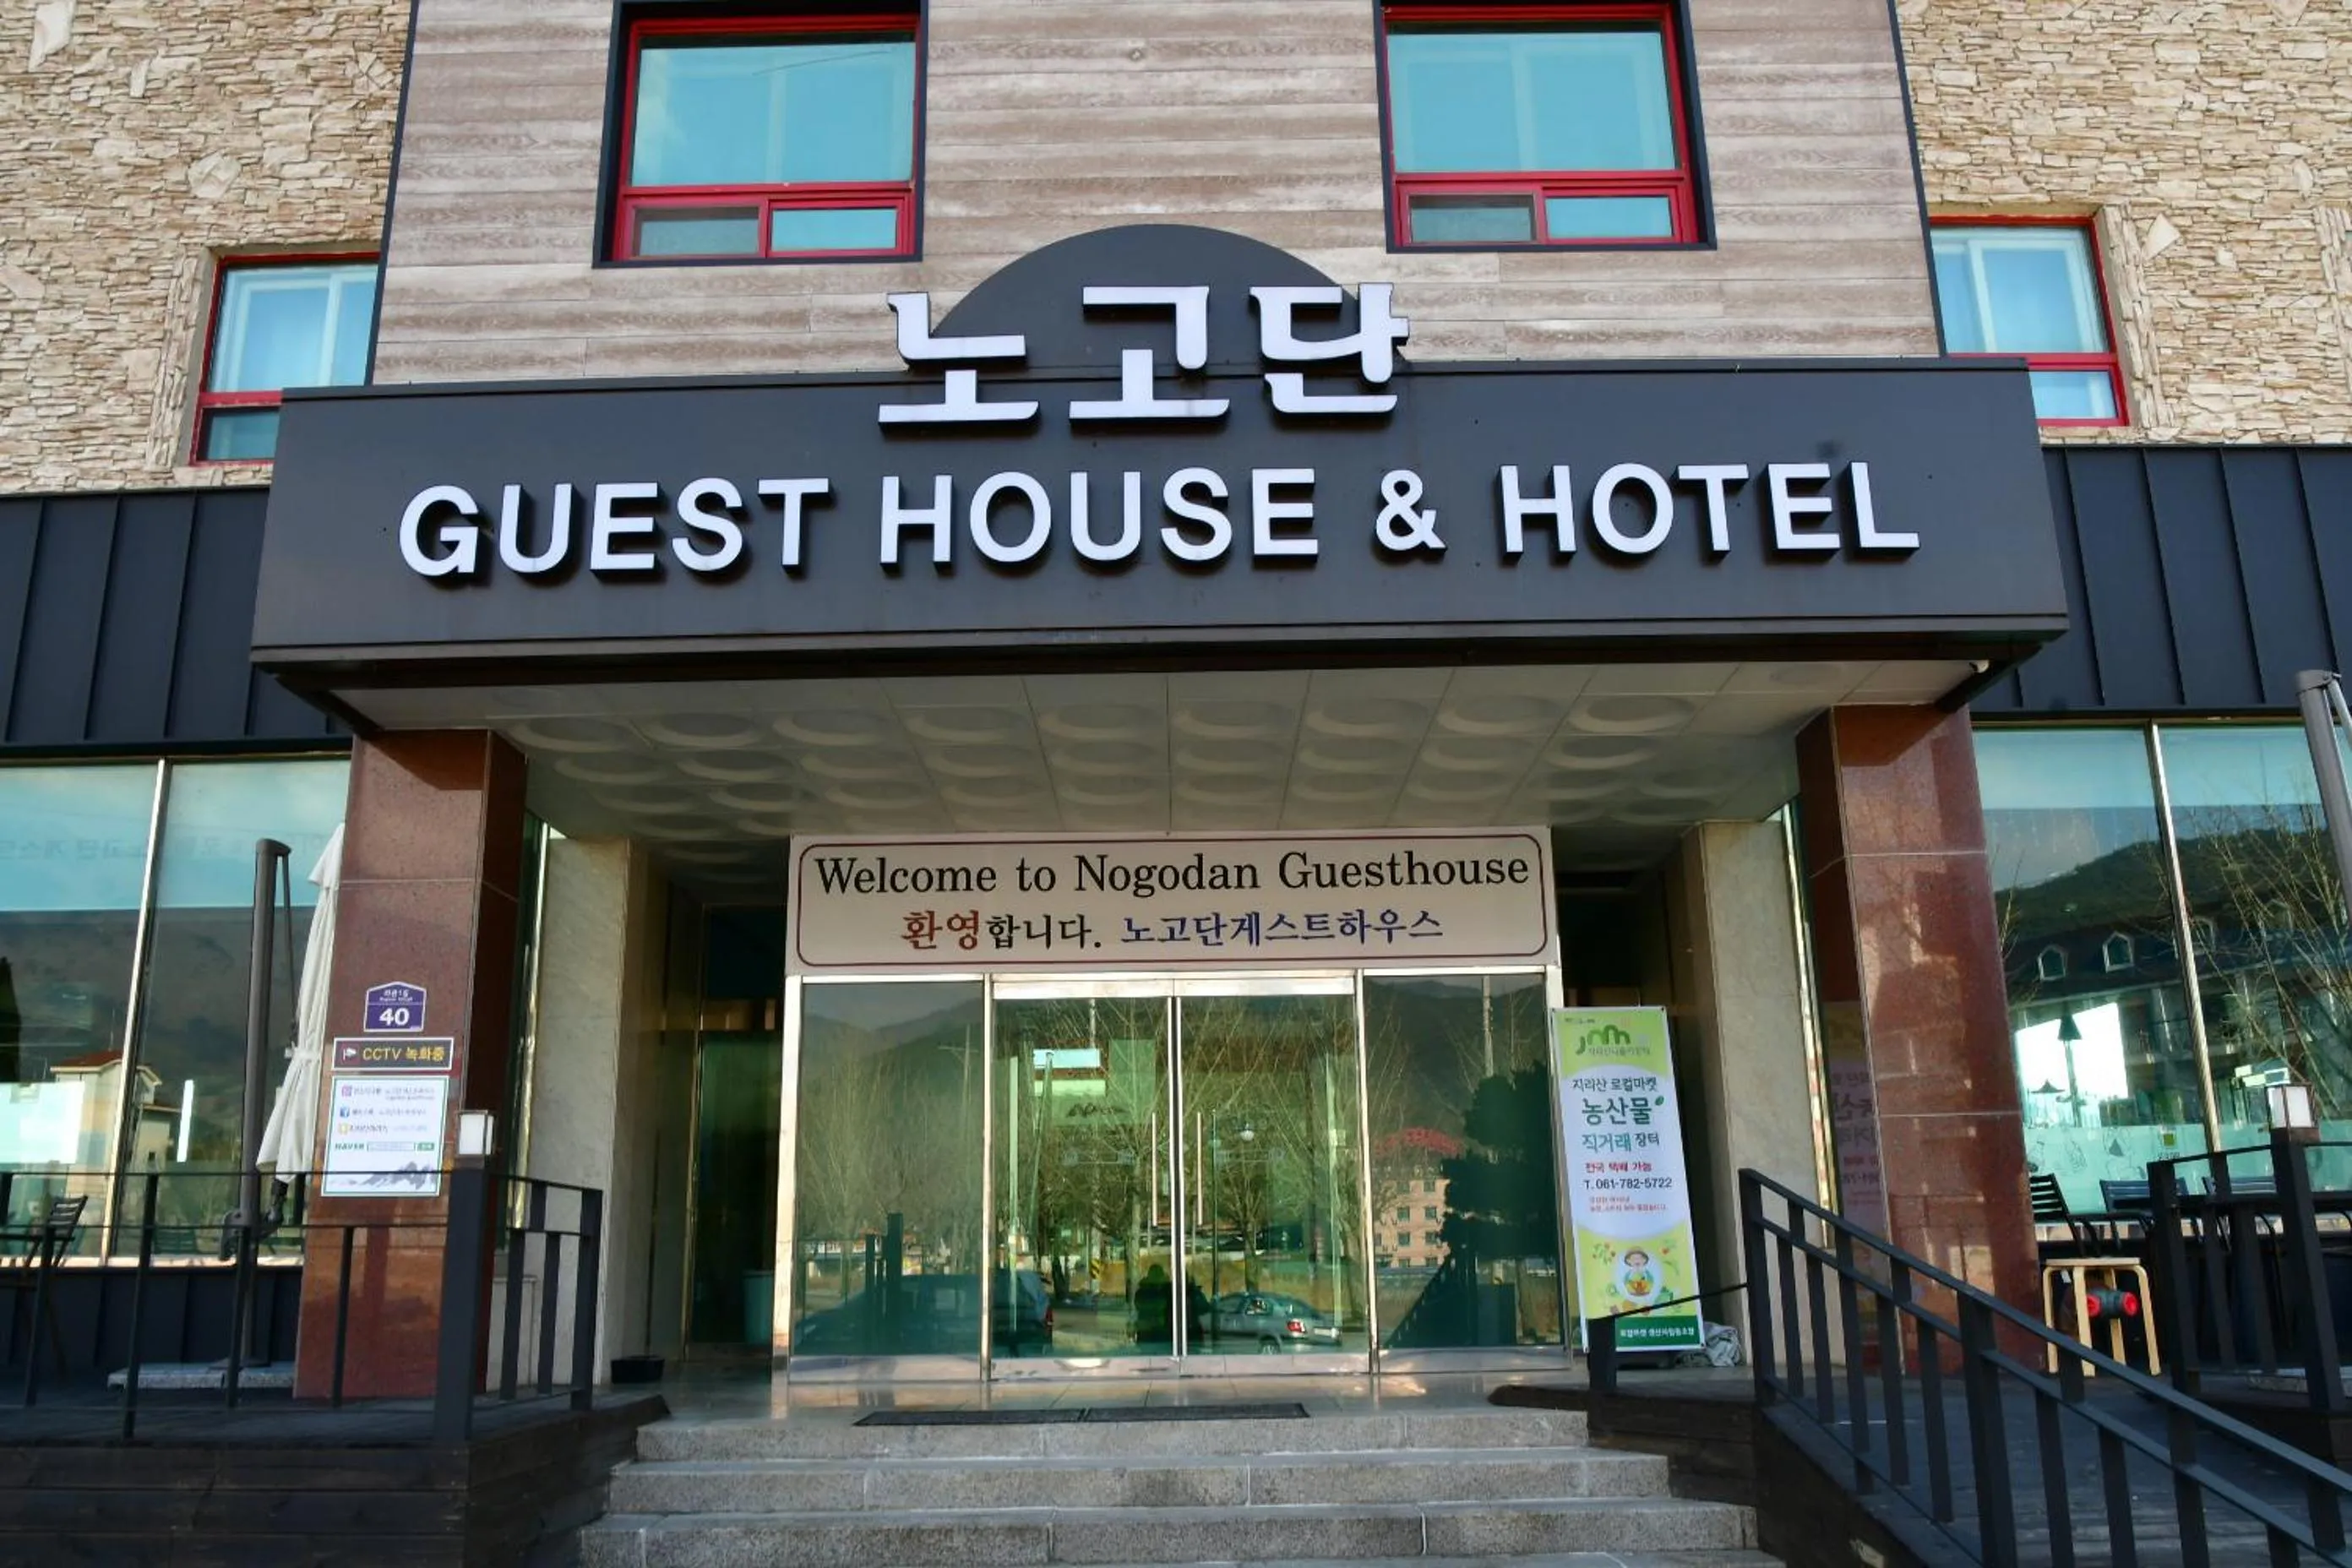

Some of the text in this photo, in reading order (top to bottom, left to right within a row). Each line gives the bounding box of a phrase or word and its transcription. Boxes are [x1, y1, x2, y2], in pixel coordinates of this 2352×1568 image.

[877, 282, 1409, 424] 노고단
[400, 461, 1919, 578] GUEST HOUSE & HOTEL
[813, 849, 1530, 899] Welcome to Nogodan Guesthouse
[901, 908, 1444, 951] 환영합니다. 노고단게스트하우스
[379, 1008, 410, 1026] 40
[363, 1048, 400, 1060] CCTV
[1573, 1079, 1607, 1092] 지리산
[1582, 1097, 1652, 1125] 농산물
[1582, 1132, 1660, 1152] 직거래 장터
